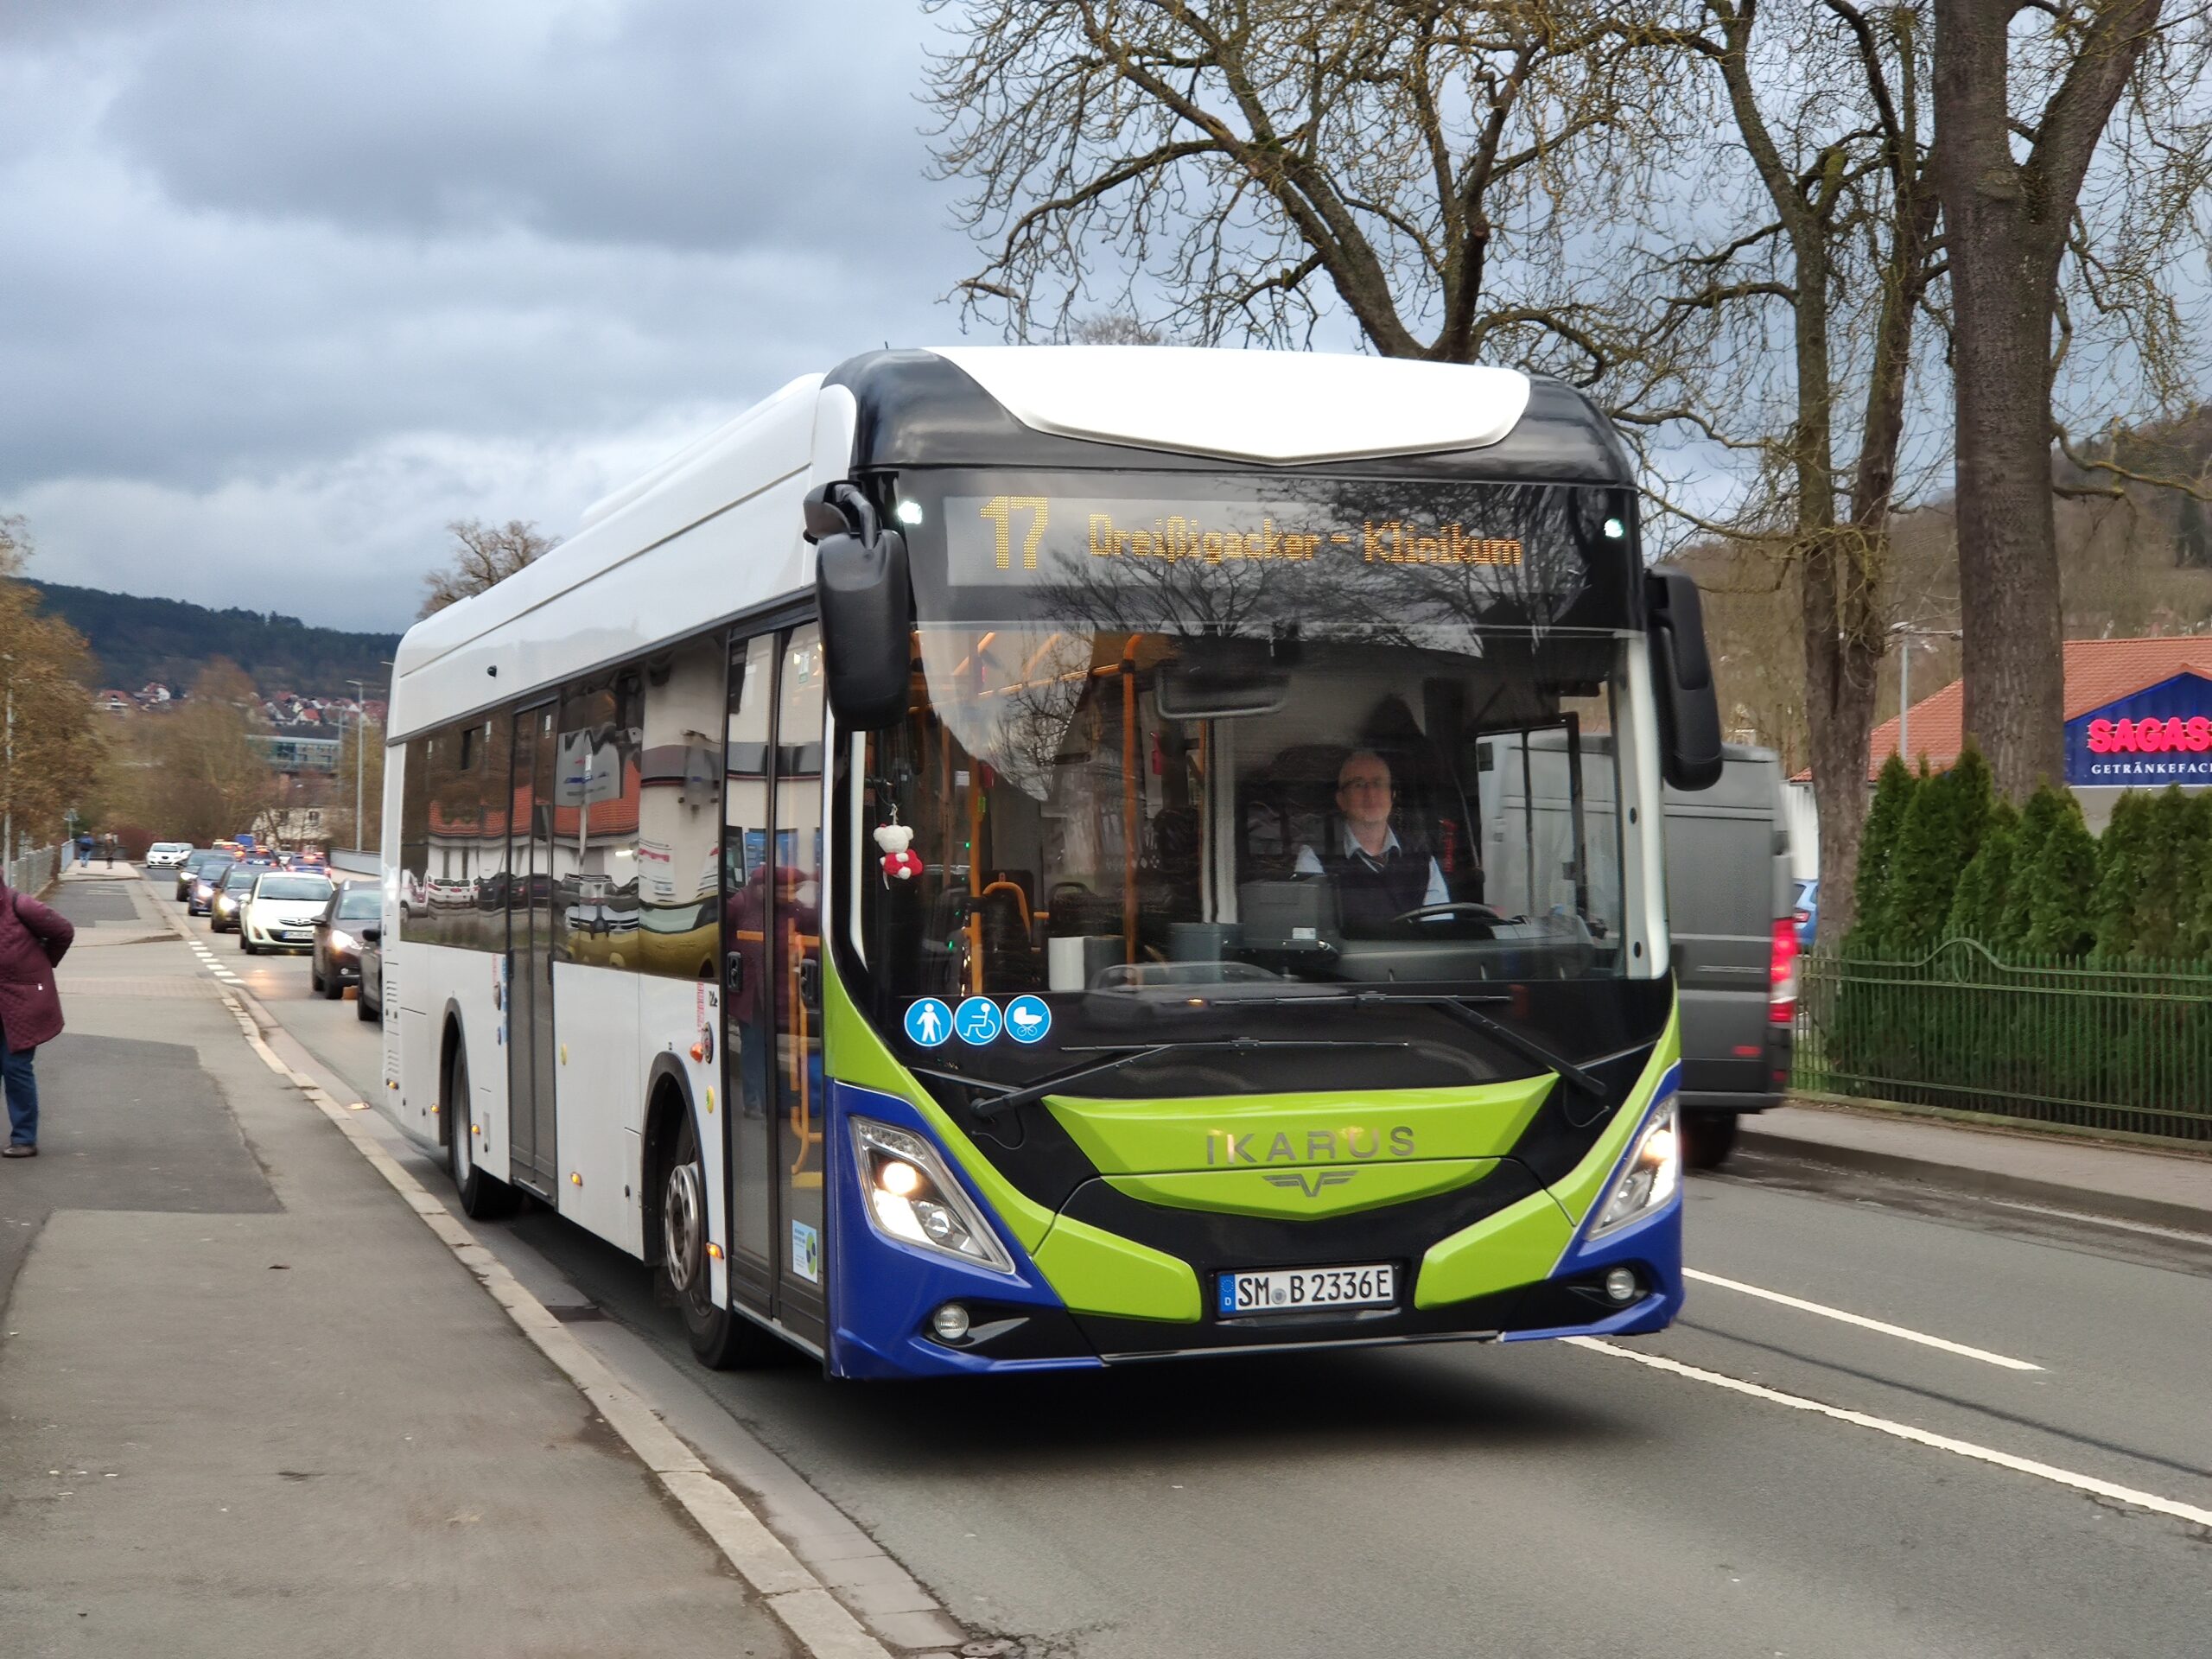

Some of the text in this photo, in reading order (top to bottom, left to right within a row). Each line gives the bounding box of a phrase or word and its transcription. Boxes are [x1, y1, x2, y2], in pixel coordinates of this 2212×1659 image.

[979, 495, 1048, 569] 17
[1089, 513, 1320, 565] Dreißigacker
[1363, 520, 1521, 565] Klinikum
[2088, 716, 2212, 753] SAGAS
[2091, 762, 2212, 774] GETRÄNKEFAC
[1207, 1126, 1414, 1165] IKARUS
[1238, 1277, 1269, 1306] SM
